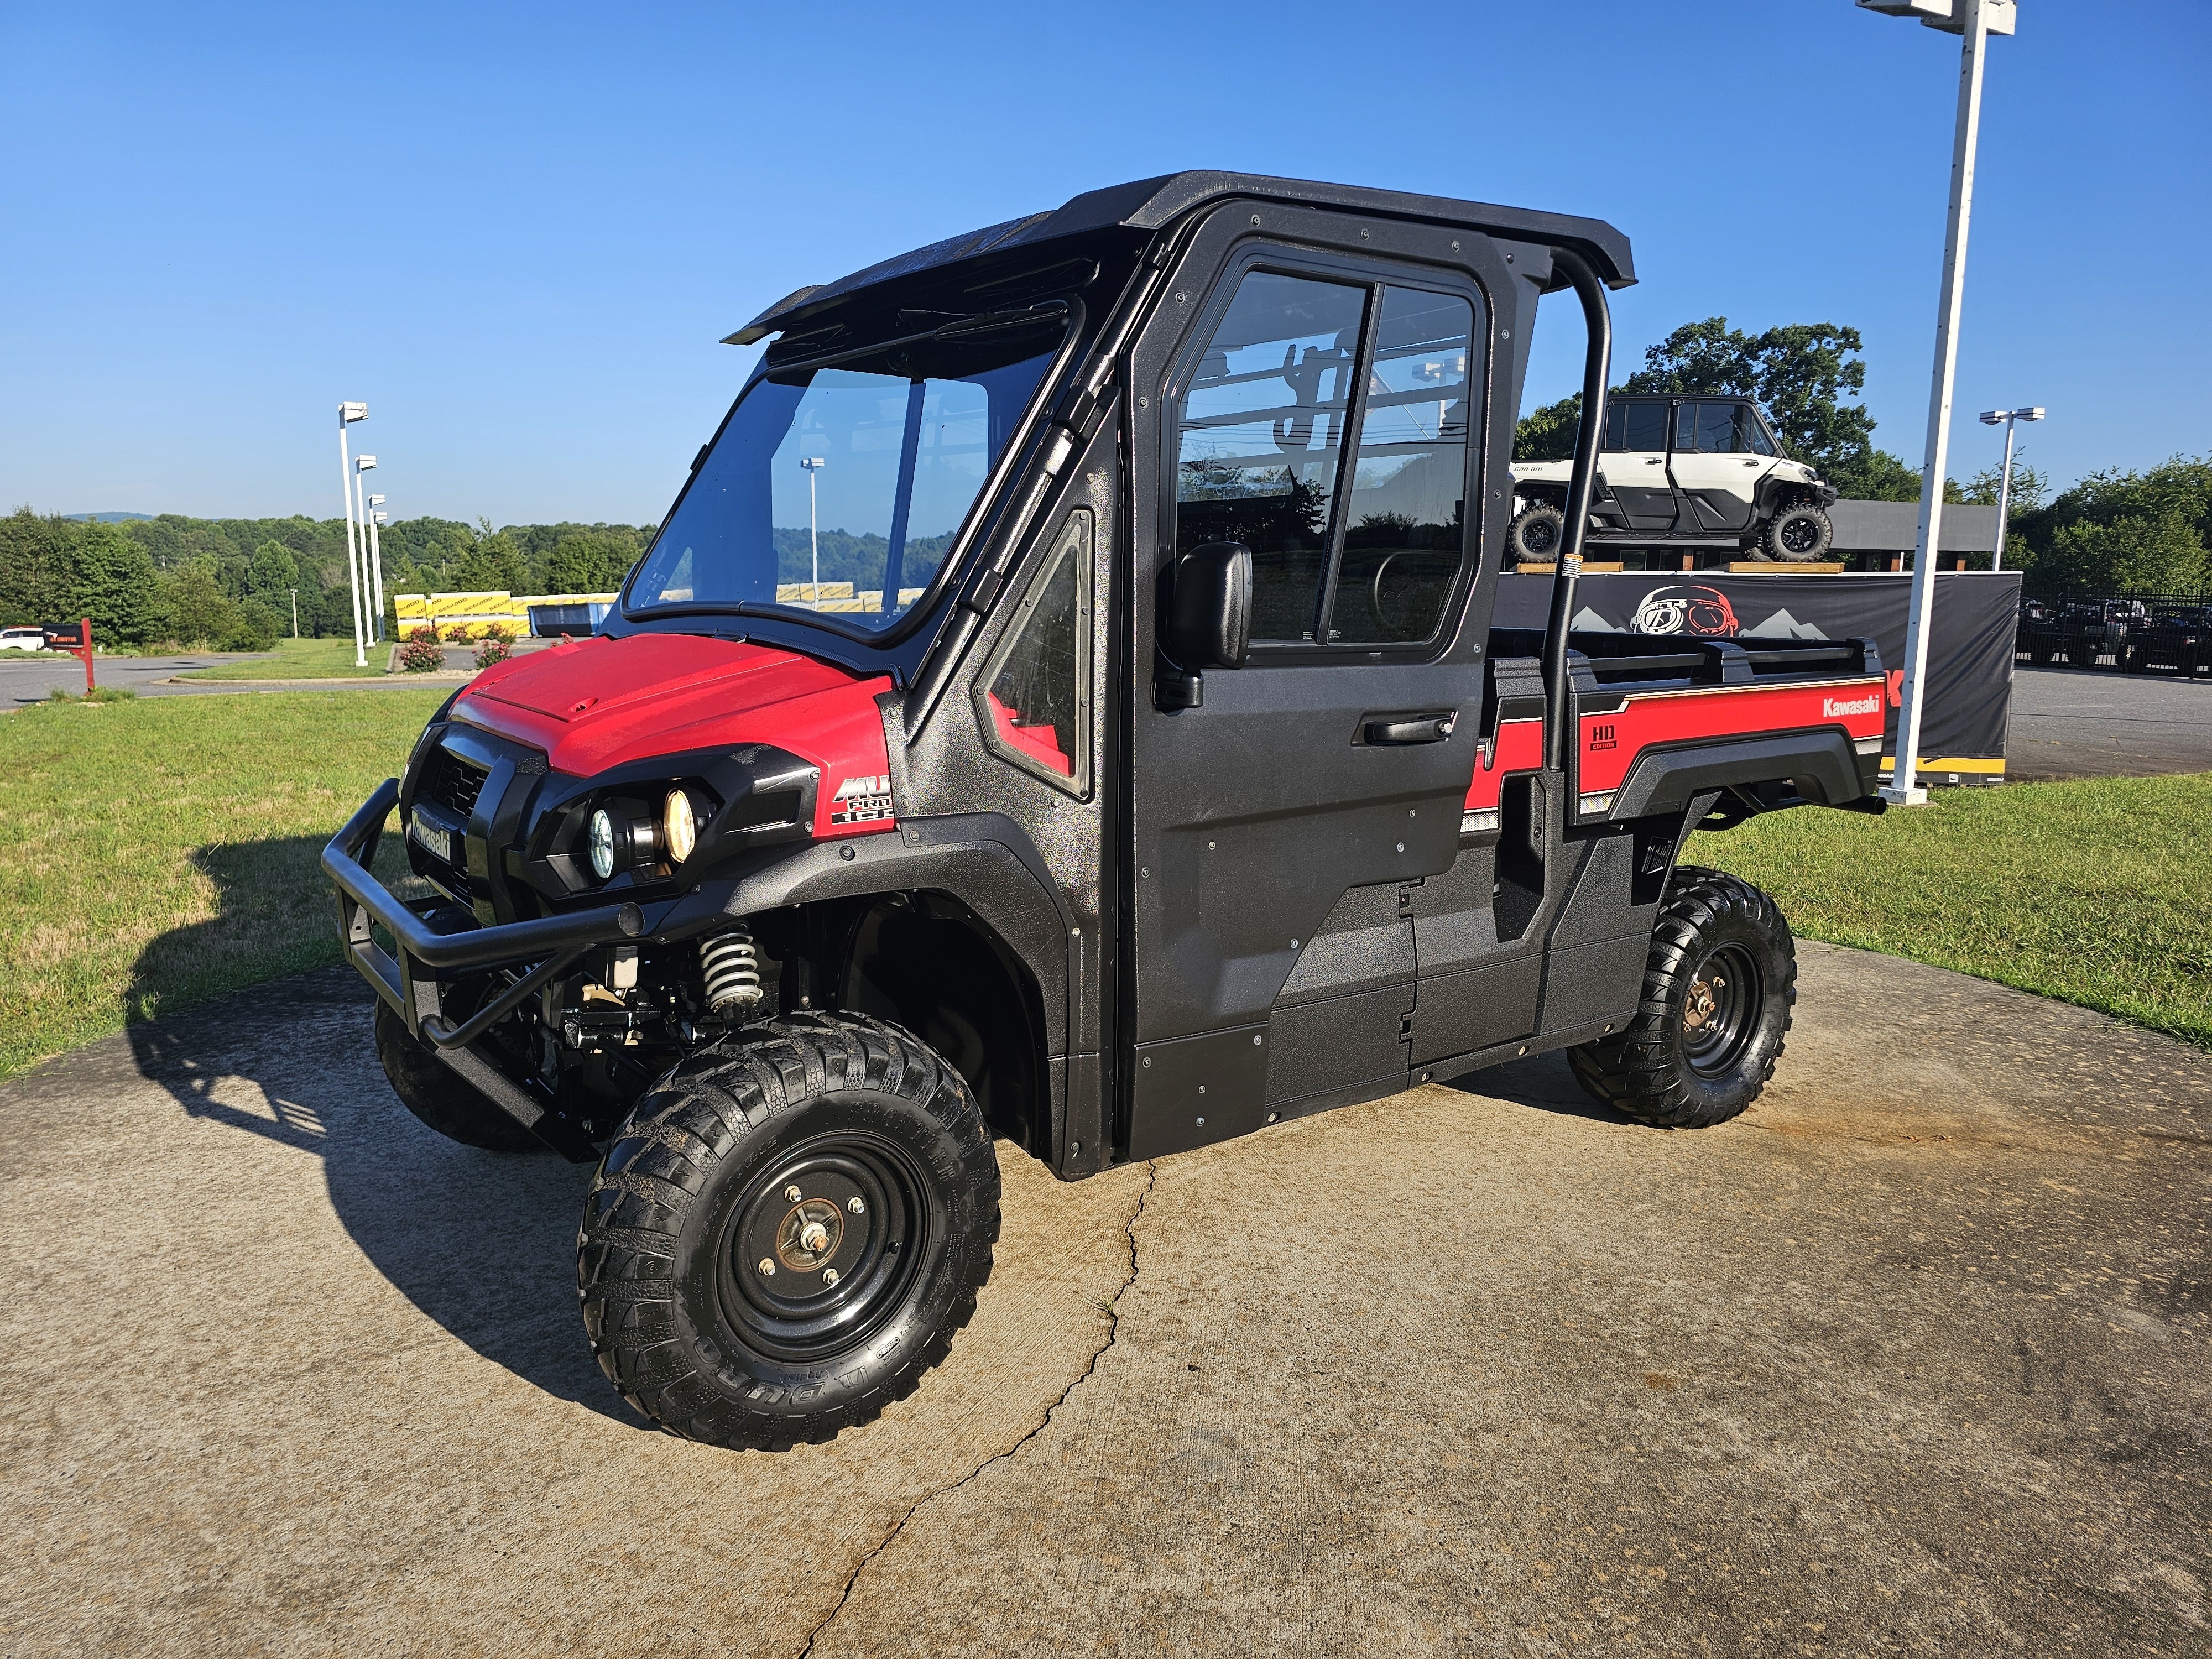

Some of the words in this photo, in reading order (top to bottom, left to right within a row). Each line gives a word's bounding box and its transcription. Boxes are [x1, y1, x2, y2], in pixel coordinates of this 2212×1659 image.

[1823, 694, 1880, 717] Kawasaki
[1593, 724, 1615, 742] HD
[411, 809, 451, 862] Kawasaki
[847, 1102, 958, 1182] FRONTIER
[693, 1335, 826, 1408] DURO
[883, 1344, 901, 1361] ROTATION
